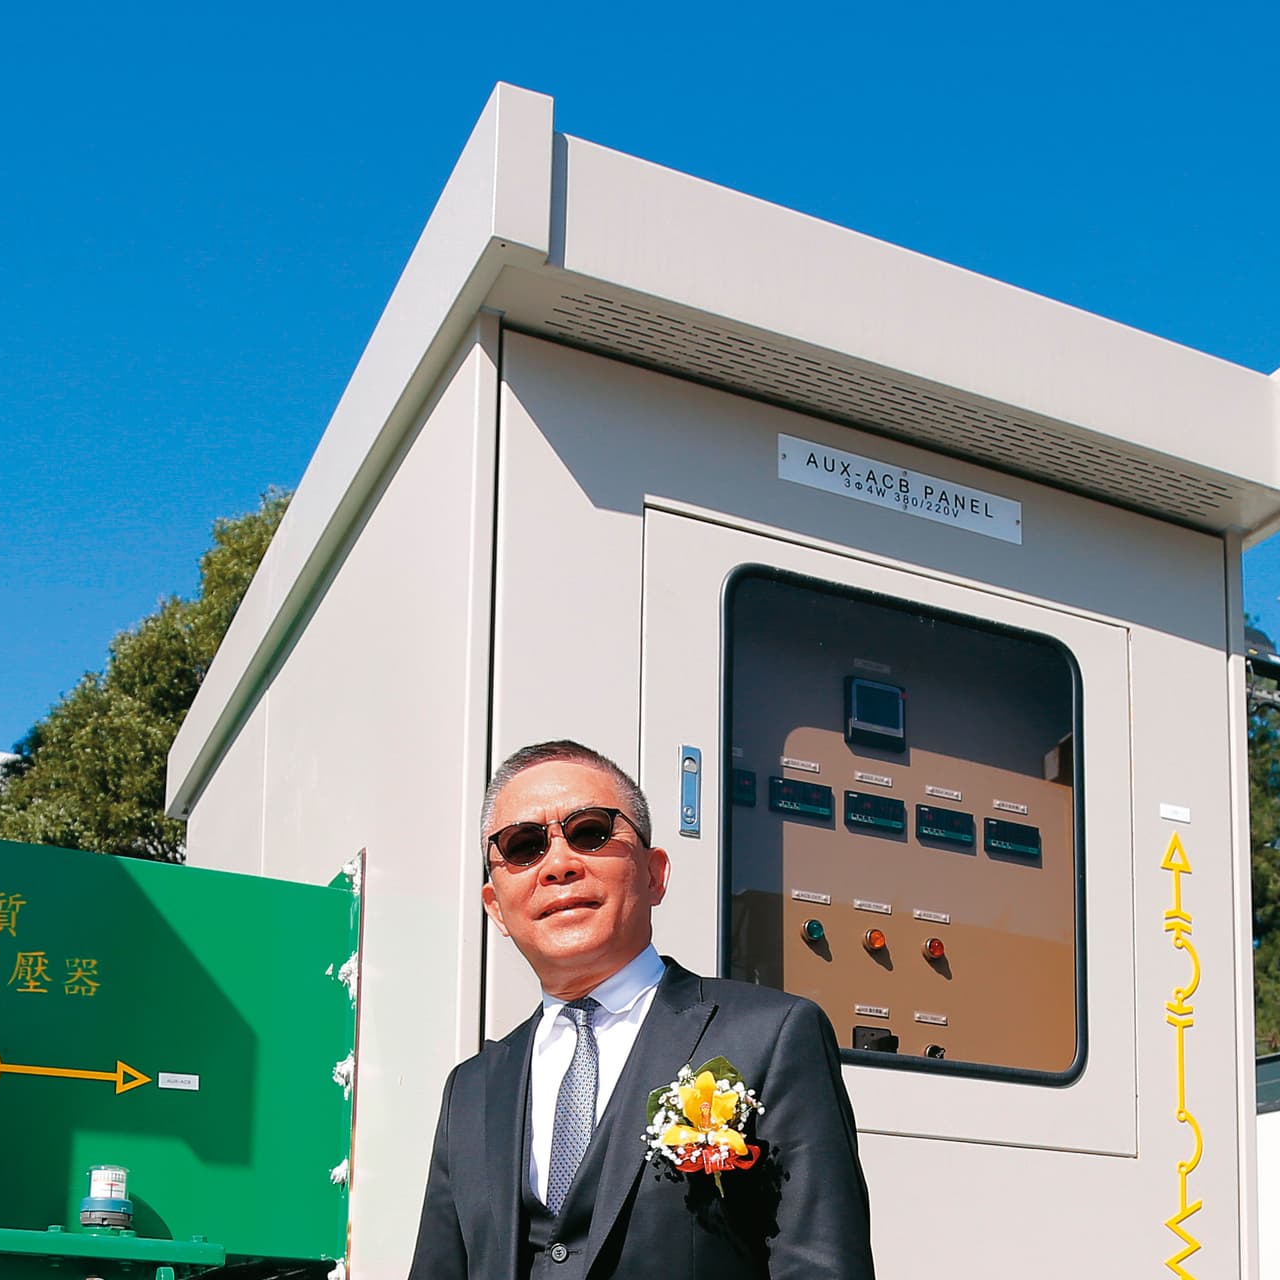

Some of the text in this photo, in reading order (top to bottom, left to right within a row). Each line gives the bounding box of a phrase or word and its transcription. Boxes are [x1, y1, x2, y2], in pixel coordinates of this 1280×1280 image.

[806, 452, 994, 519] AUX-ACB PANEL
[894, 492, 960, 519] 380/220V
